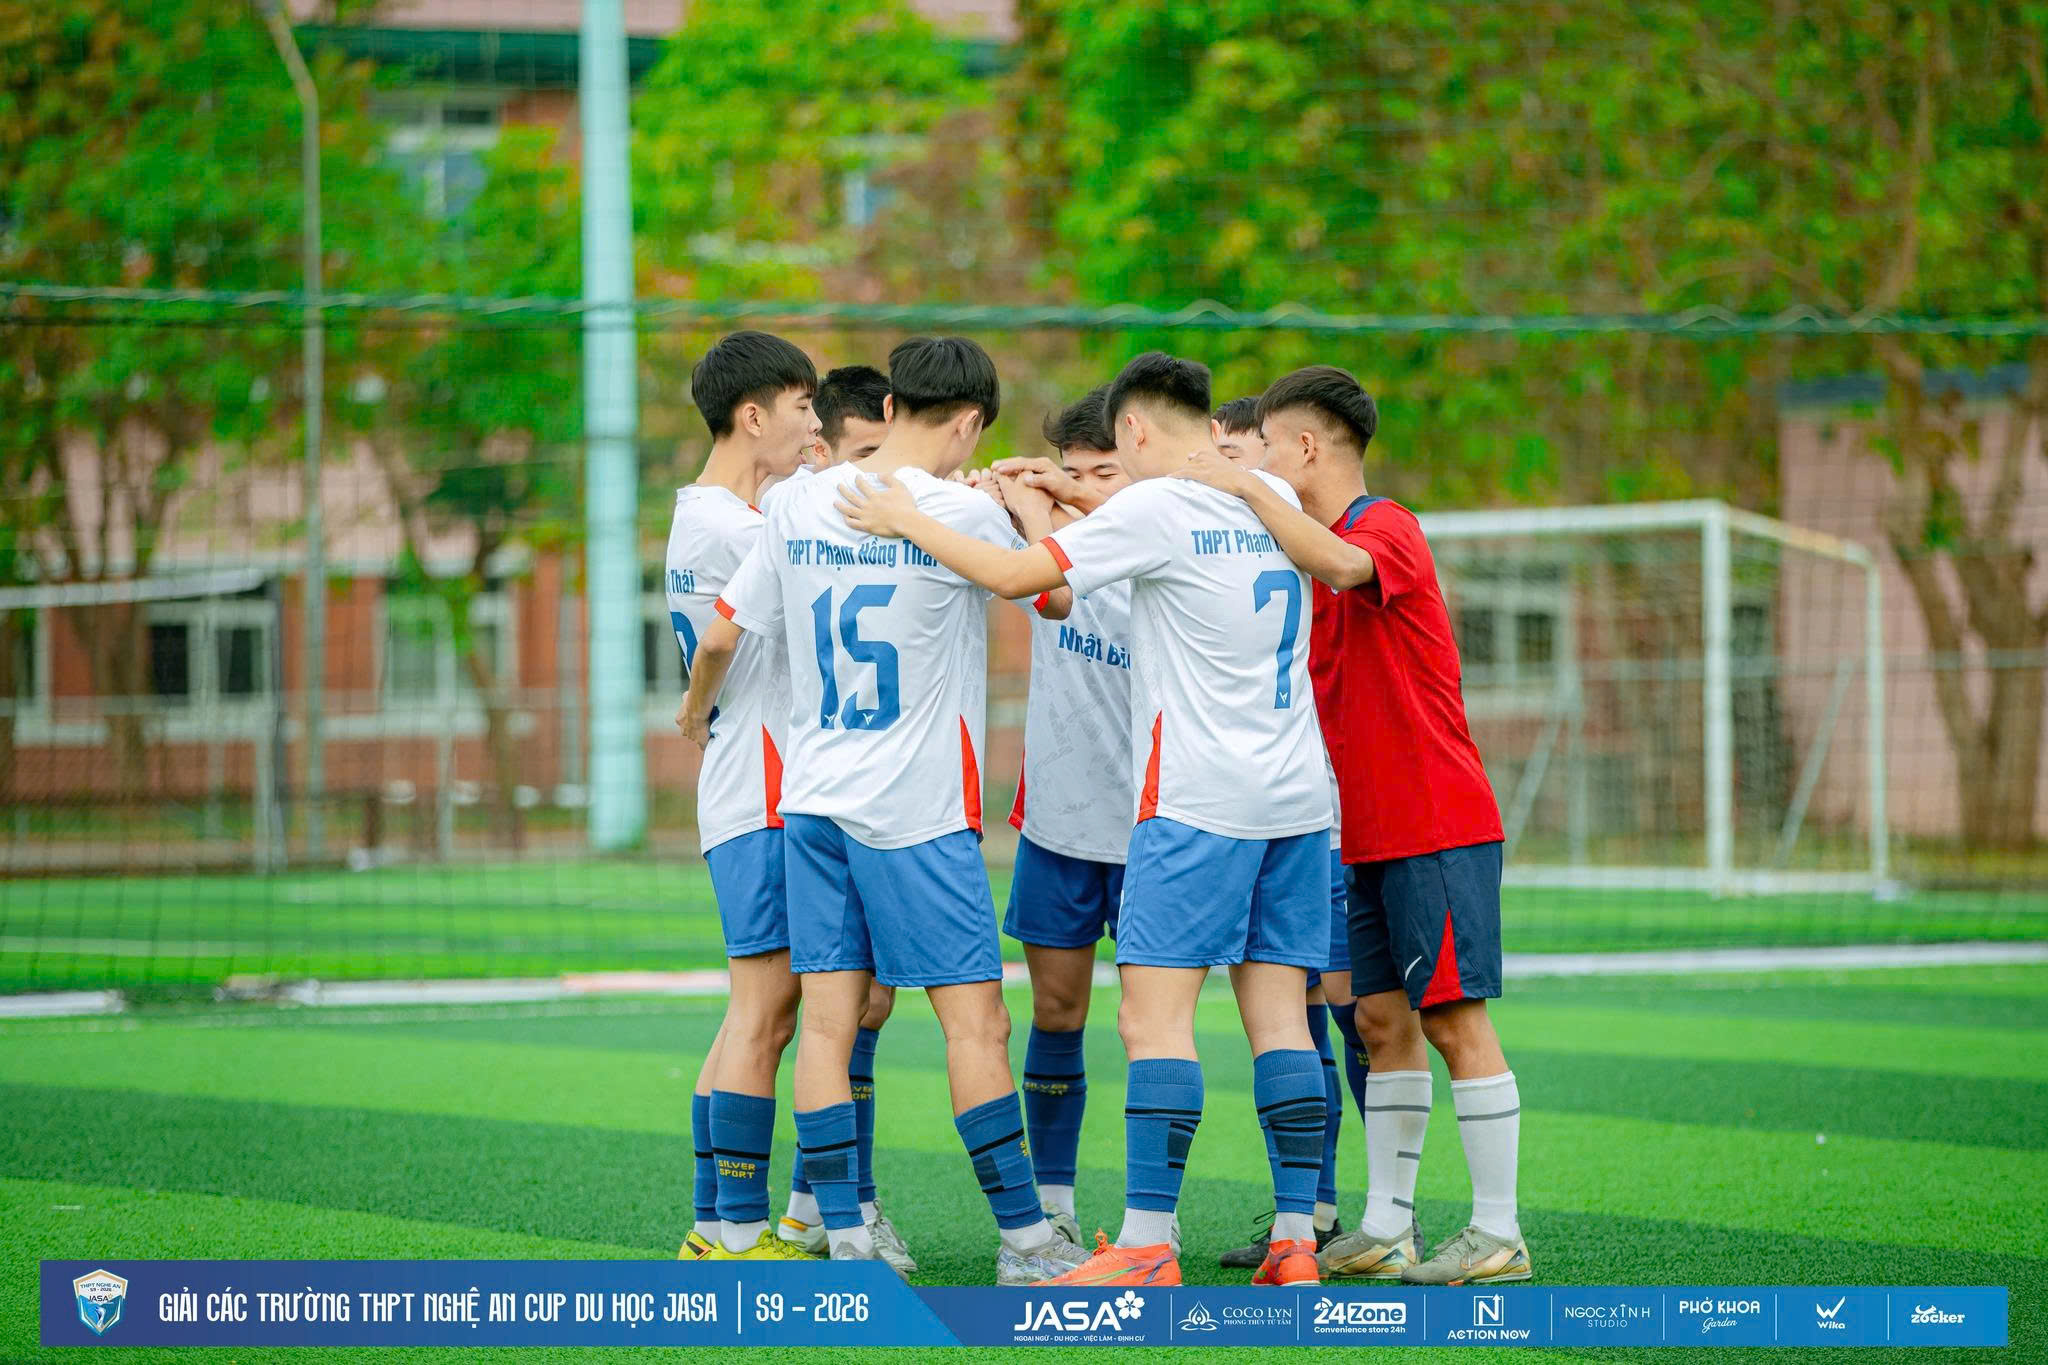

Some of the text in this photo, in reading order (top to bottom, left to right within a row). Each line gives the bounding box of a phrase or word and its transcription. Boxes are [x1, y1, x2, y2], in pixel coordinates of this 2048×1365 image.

[786, 539, 812, 566] THPT
[816, 539, 856, 571] Phạm
[859, 537, 897, 568] Hồng
[1191, 530, 1231, 555] THPT
[1234, 529, 1273, 559] Phạm
[671, 569, 695, 594] Thái
[1058, 624, 1103, 663] Nhật
[1253, 569, 1303, 709] 7
[811, 585, 900, 730] 15
[718, 1159, 756, 1171] SILVER
[720, 1168, 755, 1179] SPORT
